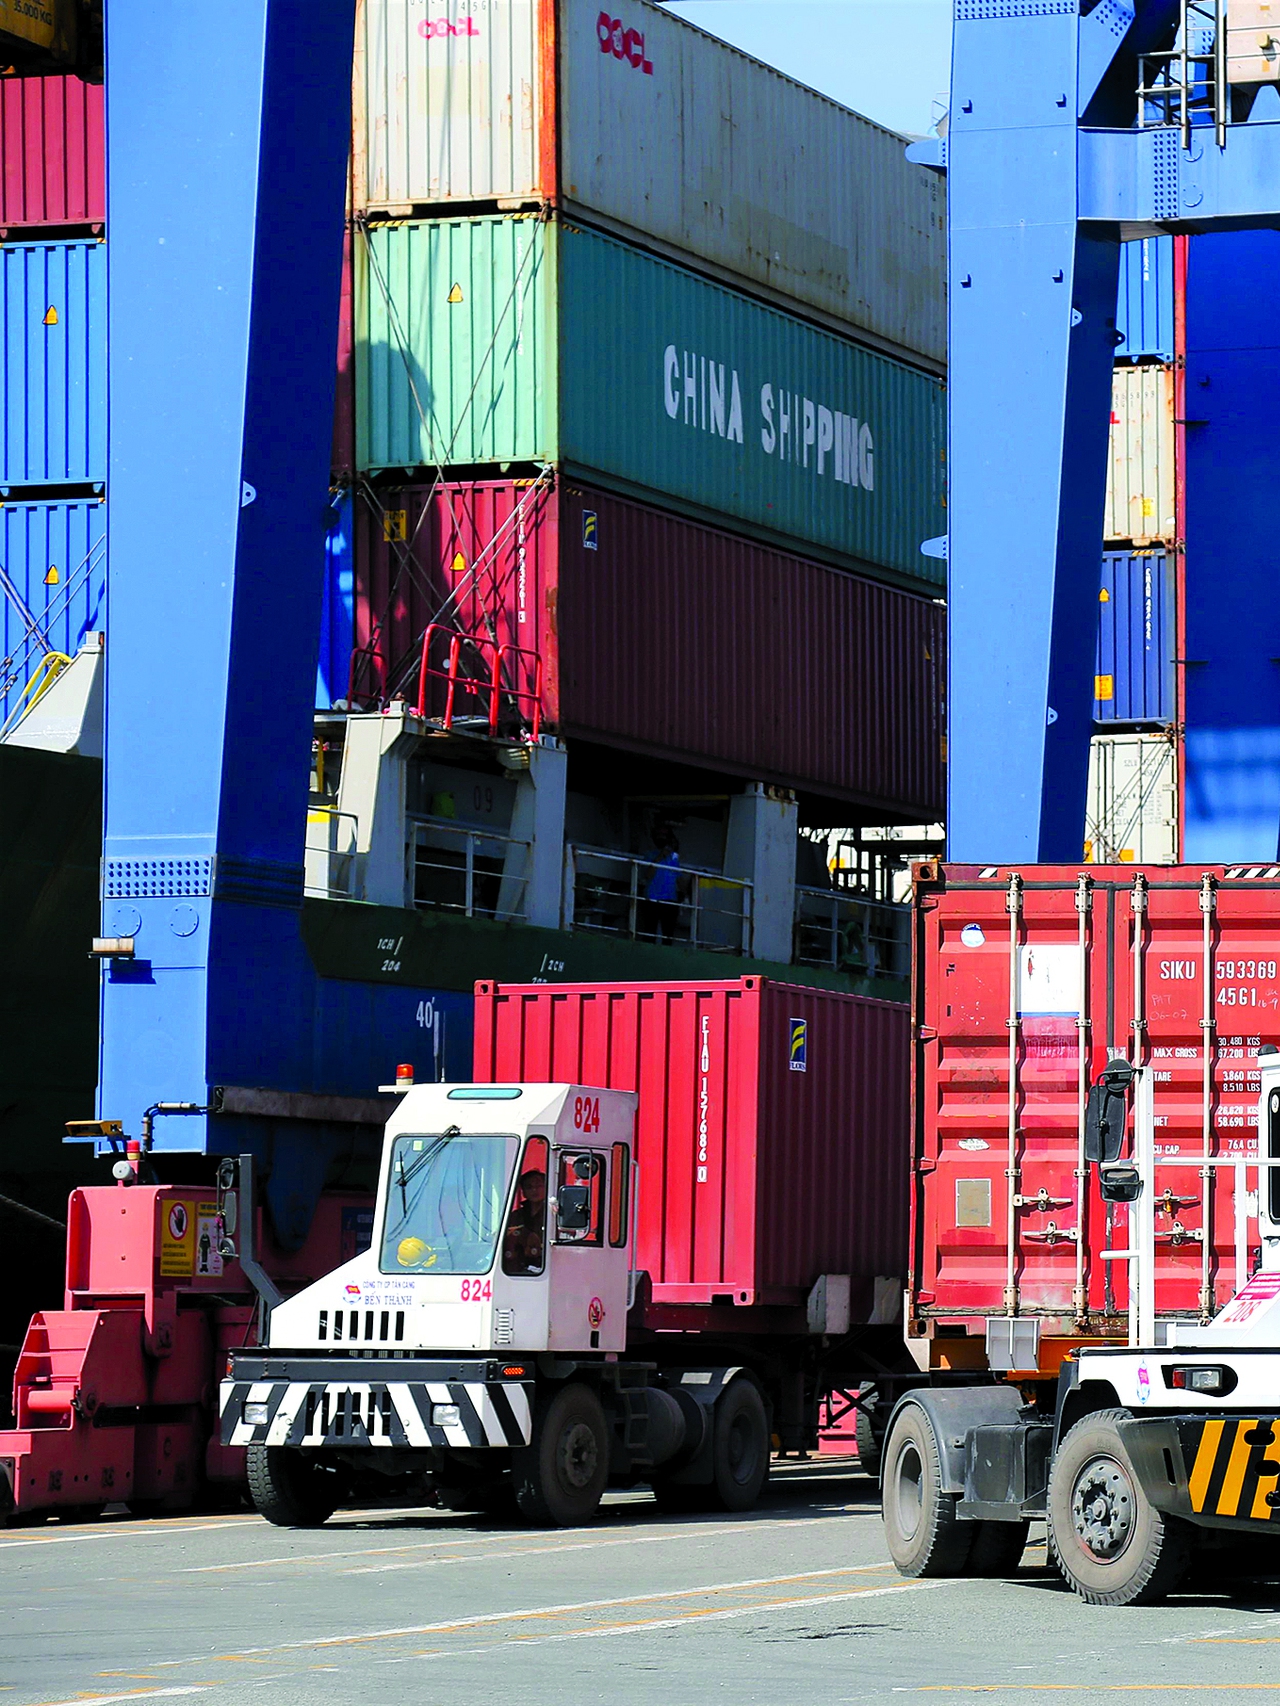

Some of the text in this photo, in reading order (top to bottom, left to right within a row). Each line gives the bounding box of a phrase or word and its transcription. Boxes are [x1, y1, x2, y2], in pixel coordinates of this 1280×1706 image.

[597, 10, 653, 76] OOCL
[663, 344, 874, 491] CHINA SHIPPING
[381, 959, 401, 972] 204
[1159, 960, 1196, 980] SIKU
[1215, 960, 1277, 980] 593369
[1216, 987, 1258, 1007] 45G1
[701, 1015, 709, 1073] FTAU
[1217, 1036, 1261, 1047] 30.480 KGS
[1153, 1047, 1260, 1059] MAX GROSS 67.200 LBS
[1153, 1070, 1261, 1082] TARE 3.860 KGS
[1222, 1082, 1261, 1093] 8.510 LBS
[573, 1096, 601, 1134] 824
[698, 1076, 708, 1163] 157686
[1153, 1116, 1169, 1127] NET
[1217, 1116, 1244, 1127] 58.690
[384, 1293, 413, 1306] THÀNH
[460, 1278, 493, 1303] 824
[1222, 1300, 1262, 1323] 208
